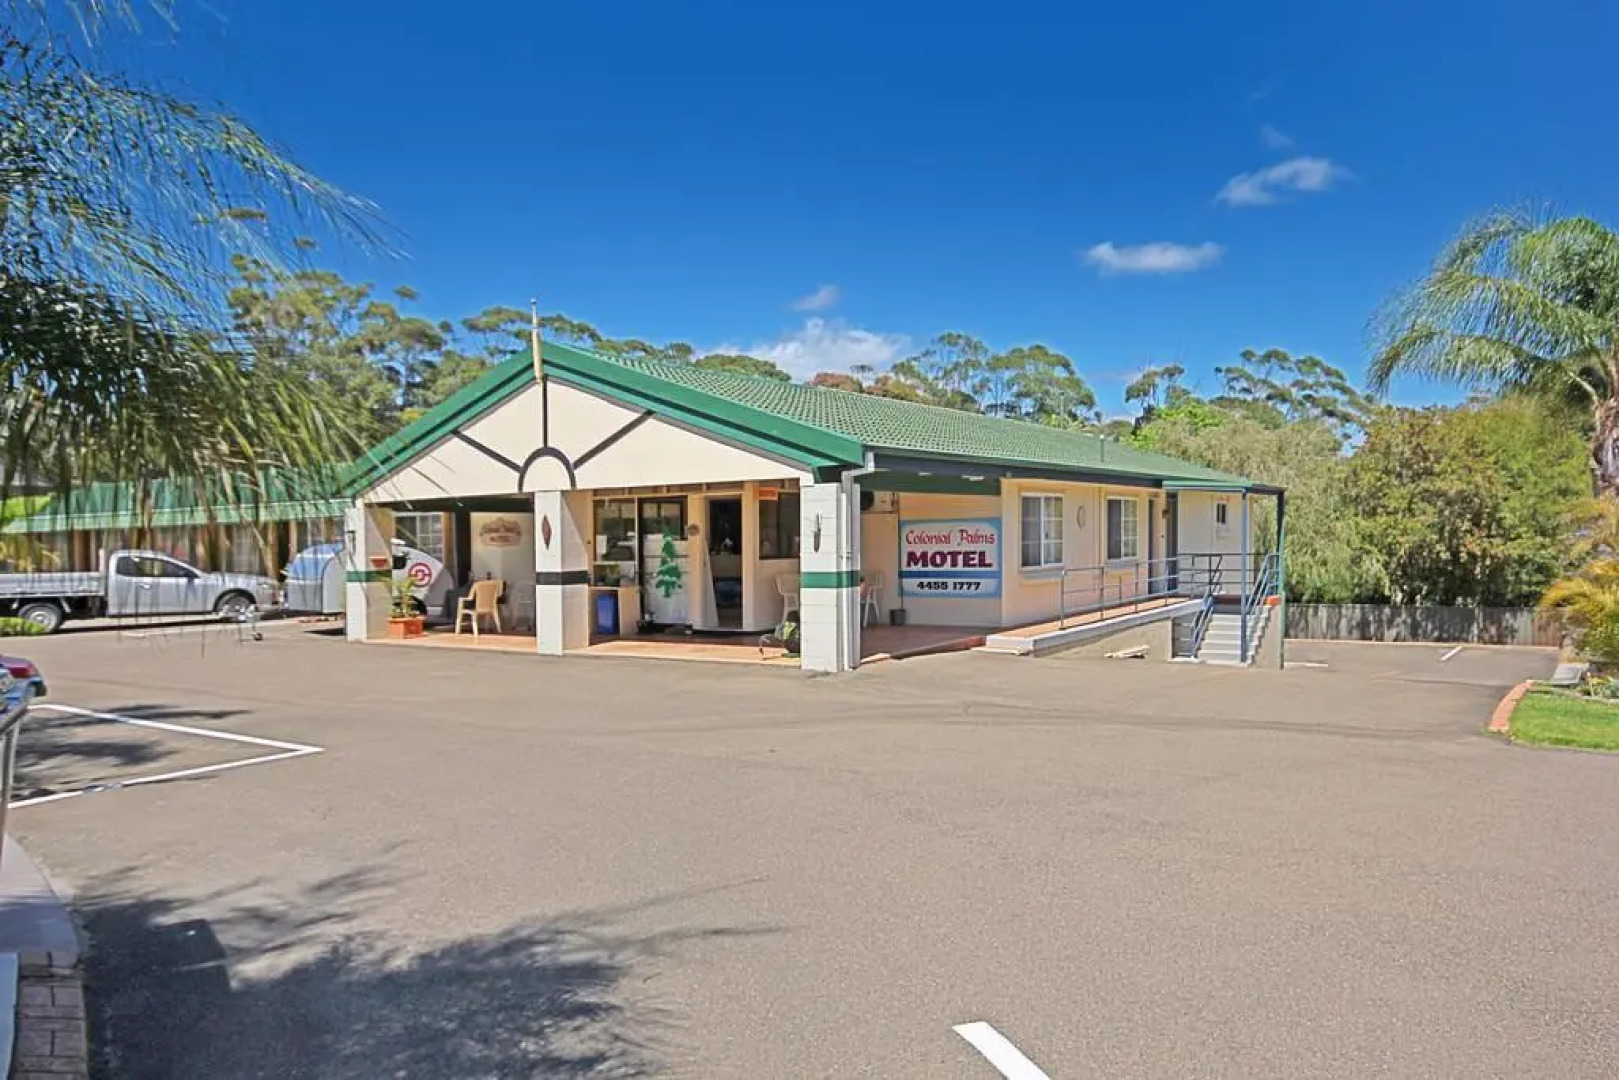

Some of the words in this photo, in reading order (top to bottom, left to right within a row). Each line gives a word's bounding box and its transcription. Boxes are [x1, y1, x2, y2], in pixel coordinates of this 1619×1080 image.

[906, 530, 951, 545] Colonial
[955, 529, 995, 546] Palms
[906, 550, 993, 567] MOTEL
[917, 581, 948, 590] 4455
[953, 581, 981, 590] 1777
